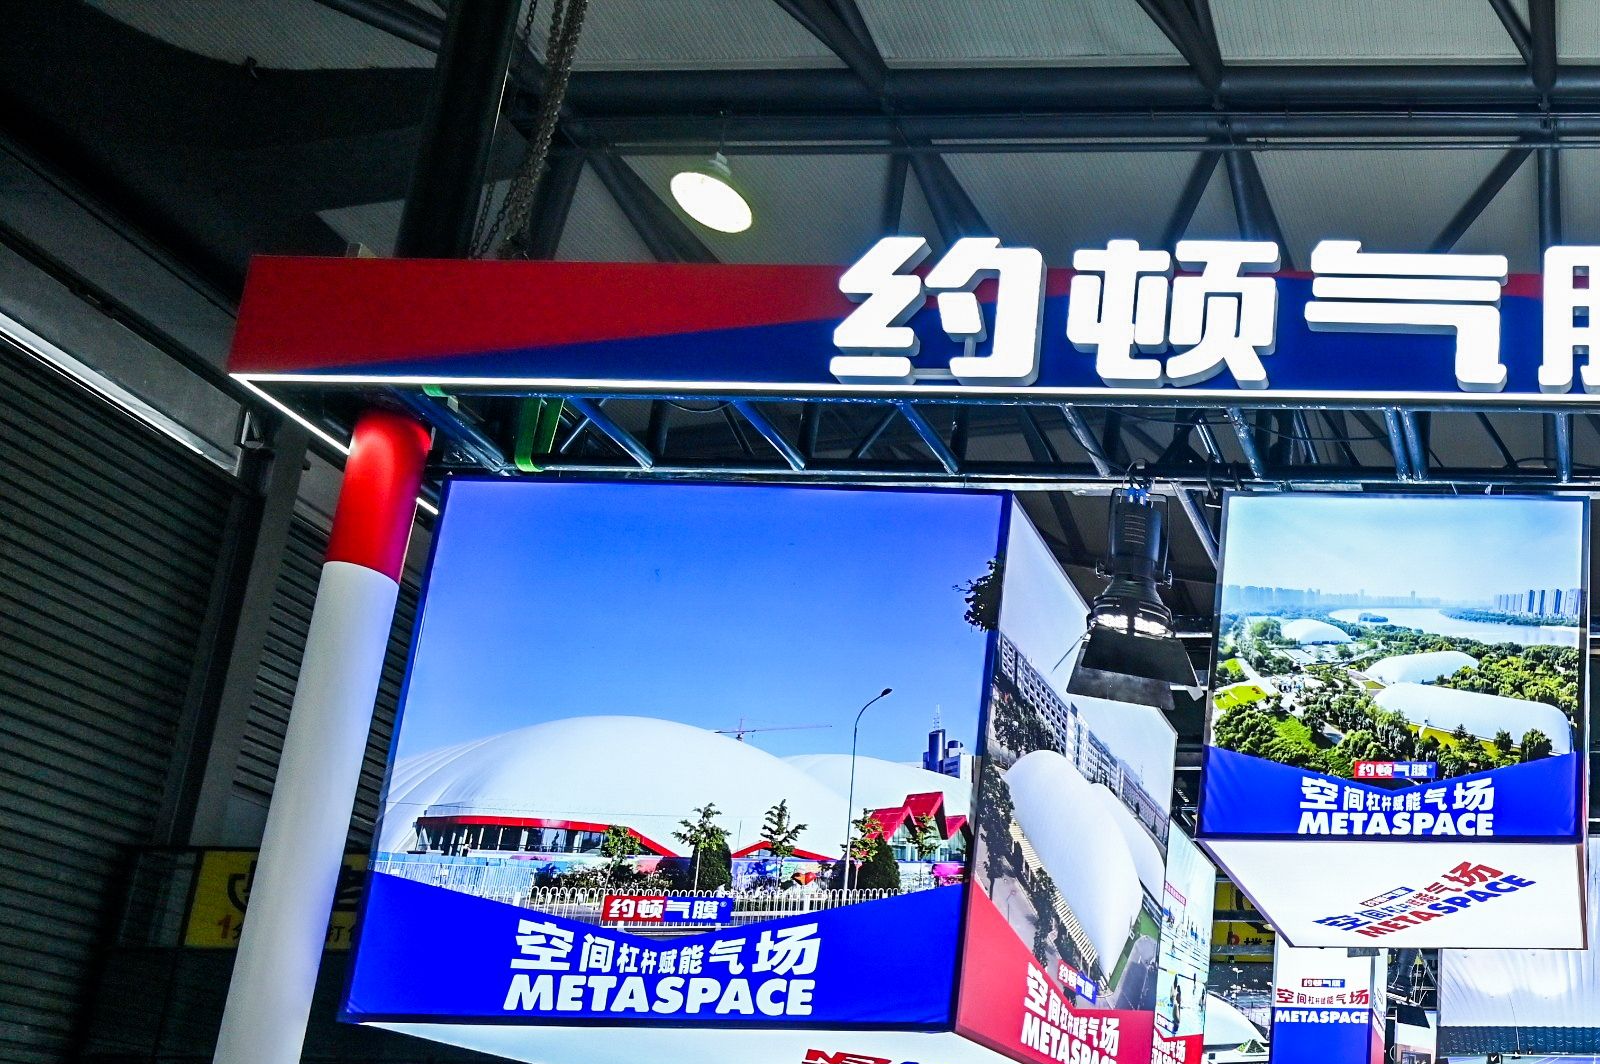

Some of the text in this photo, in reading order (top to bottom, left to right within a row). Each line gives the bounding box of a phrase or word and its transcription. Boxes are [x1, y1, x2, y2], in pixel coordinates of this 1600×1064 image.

[1301, 777, 1495, 811] 空间杠杆赋能气场
[1298, 811, 1494, 836] METASPACE
[1356, 874, 1537, 938] METASPACE
[510, 918, 823, 976] 空间杠杆赋能气场
[502, 974, 817, 1016] METASPACE
[1275, 1010, 1369, 1024] METASPACE
